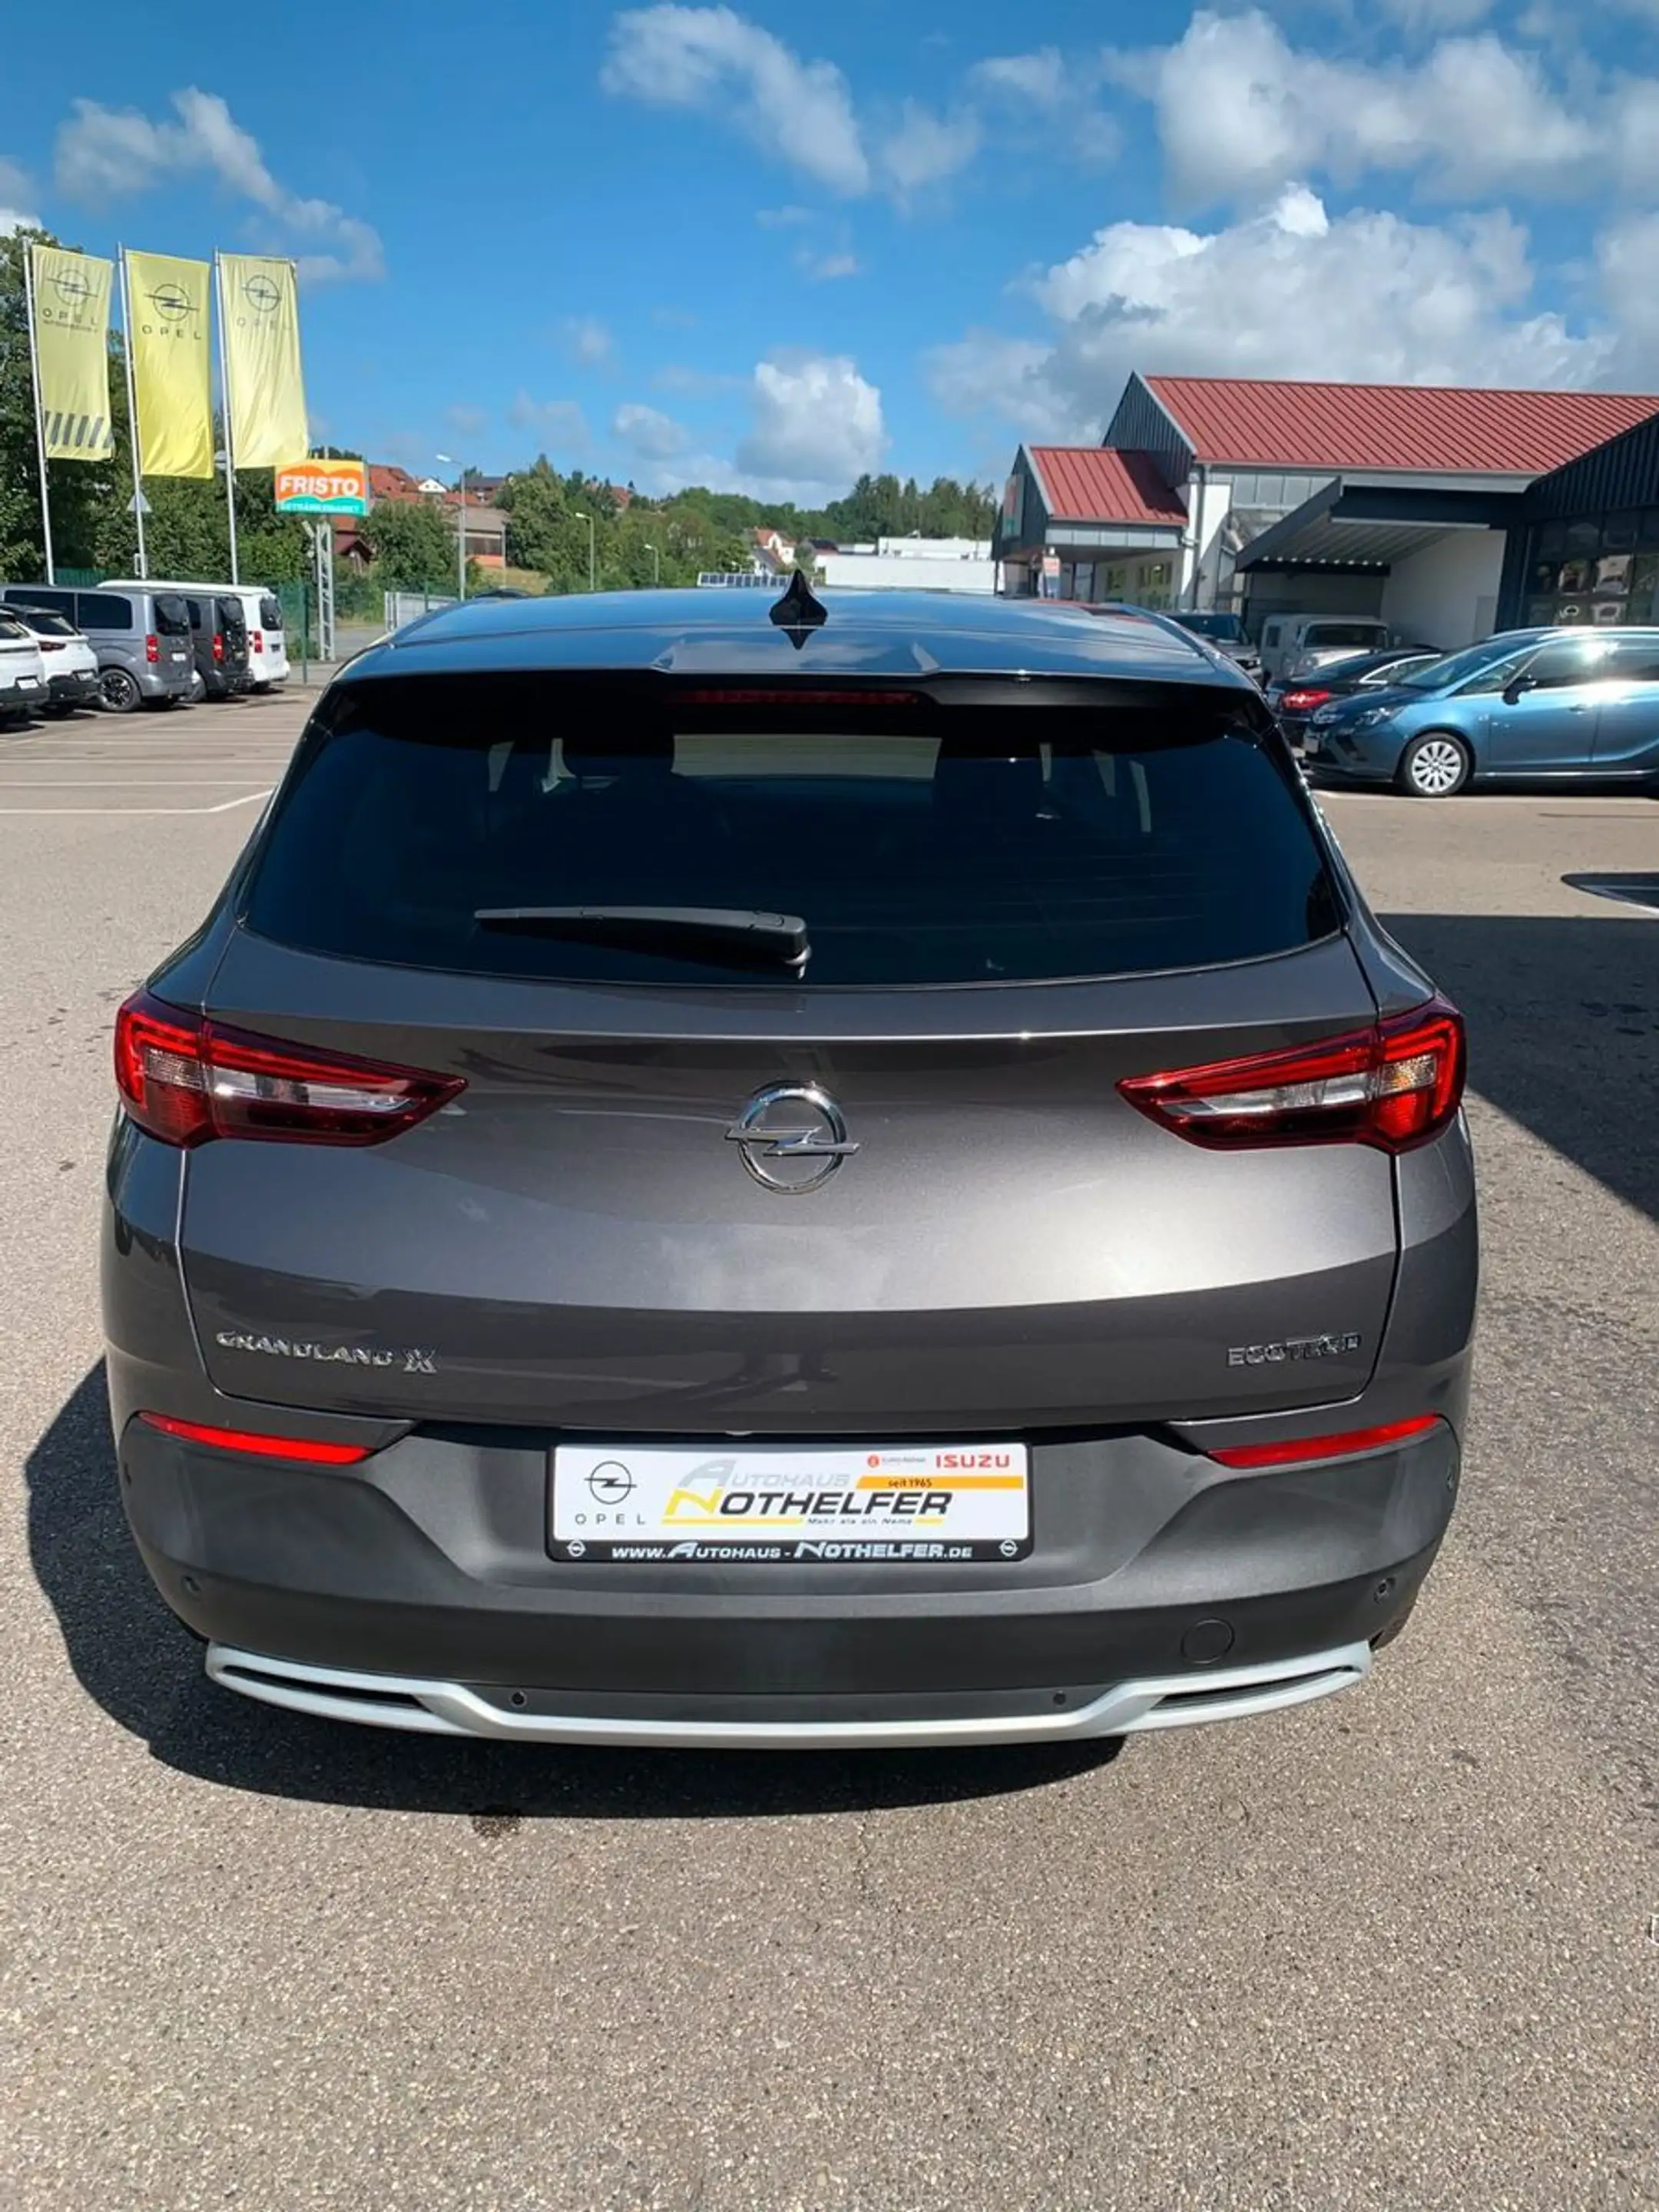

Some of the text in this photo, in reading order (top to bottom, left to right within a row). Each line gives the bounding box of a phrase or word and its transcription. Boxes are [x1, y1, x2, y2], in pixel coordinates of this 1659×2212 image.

[42, 307, 99, 326] OPEL
[141, 324, 201, 340] OPEL
[280, 475, 359, 496] FRISTO
[216, 1330, 438, 1374] GRANDLAND X
[935, 1453, 1011, 1469] ISUZU
[677, 1459, 851, 1488] AUTOHAUS
[888, 1477, 932, 1488] seit 1965
[665, 1488, 953, 1515] NOTHELFER
[575, 1513, 646, 1525] OPEL
